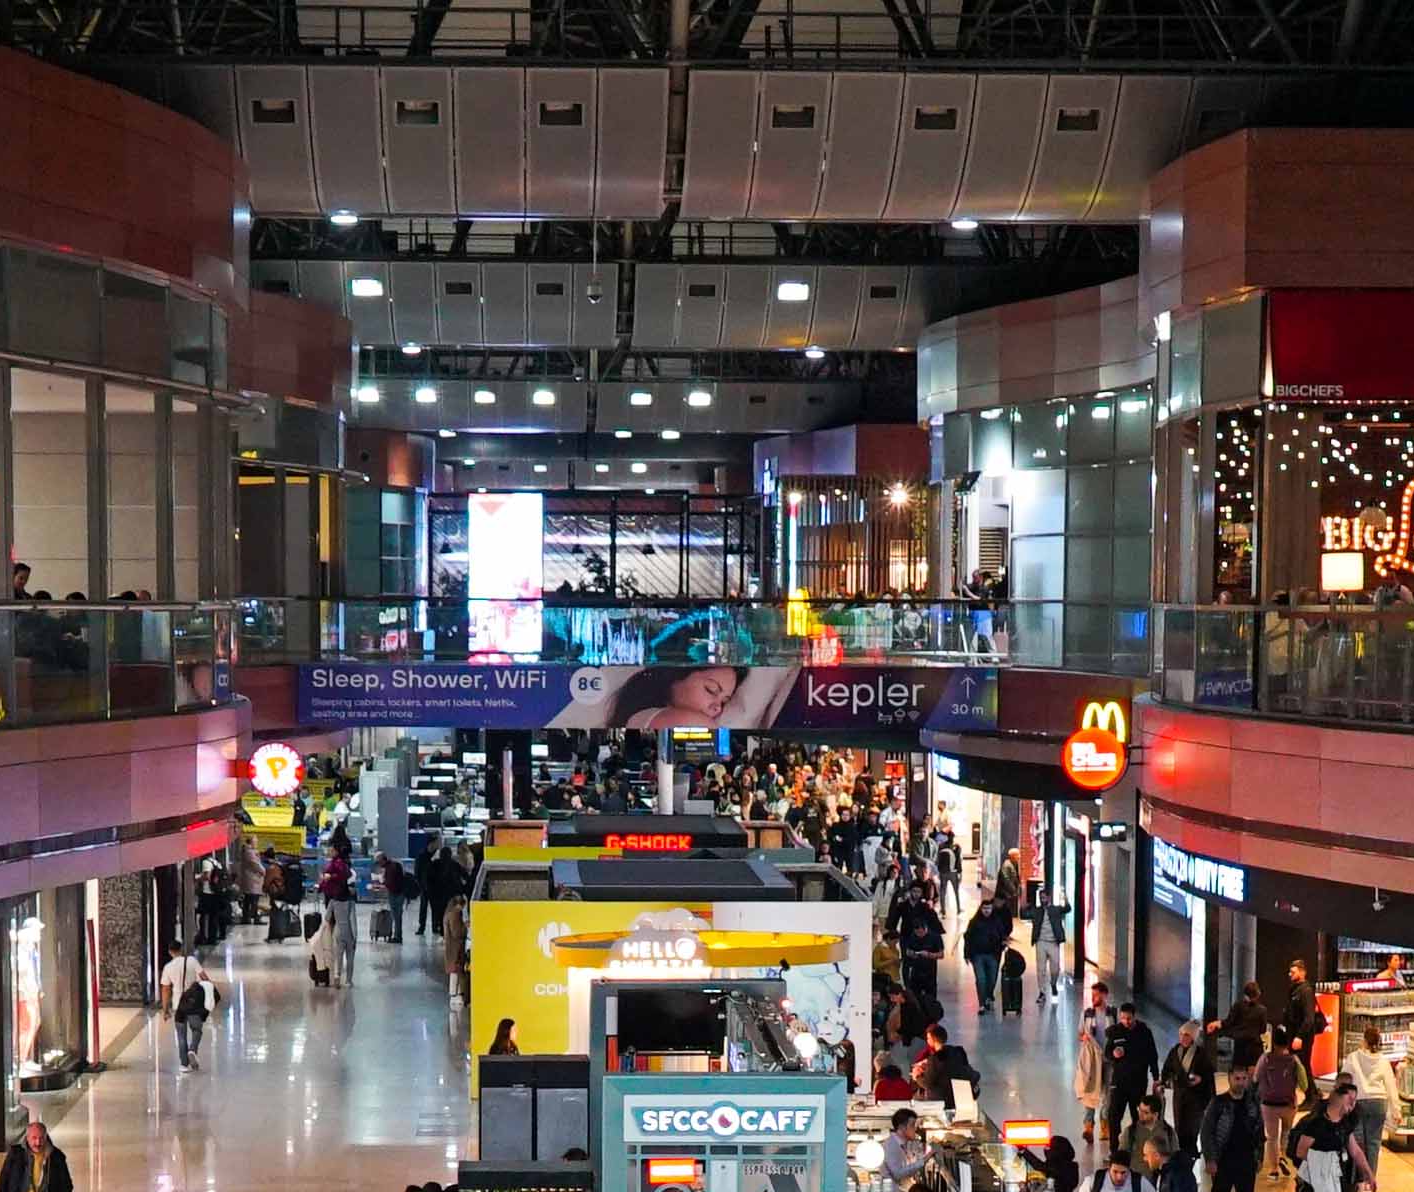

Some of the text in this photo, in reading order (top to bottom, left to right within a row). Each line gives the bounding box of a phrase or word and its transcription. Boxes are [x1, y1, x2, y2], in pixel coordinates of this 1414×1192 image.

[1275, 384, 1344, 398] BIGCHEFS
[1320, 515, 1396, 552] BIG
[312, 669, 547, 693] Sleep, Shower, WiFi
[577, 679, 602, 692] 8€
[807, 675, 925, 714] kepler
[950, 703, 984, 716] 30 m
[622, 938, 696, 959] HELLO
[534, 983, 569, 996] COM
